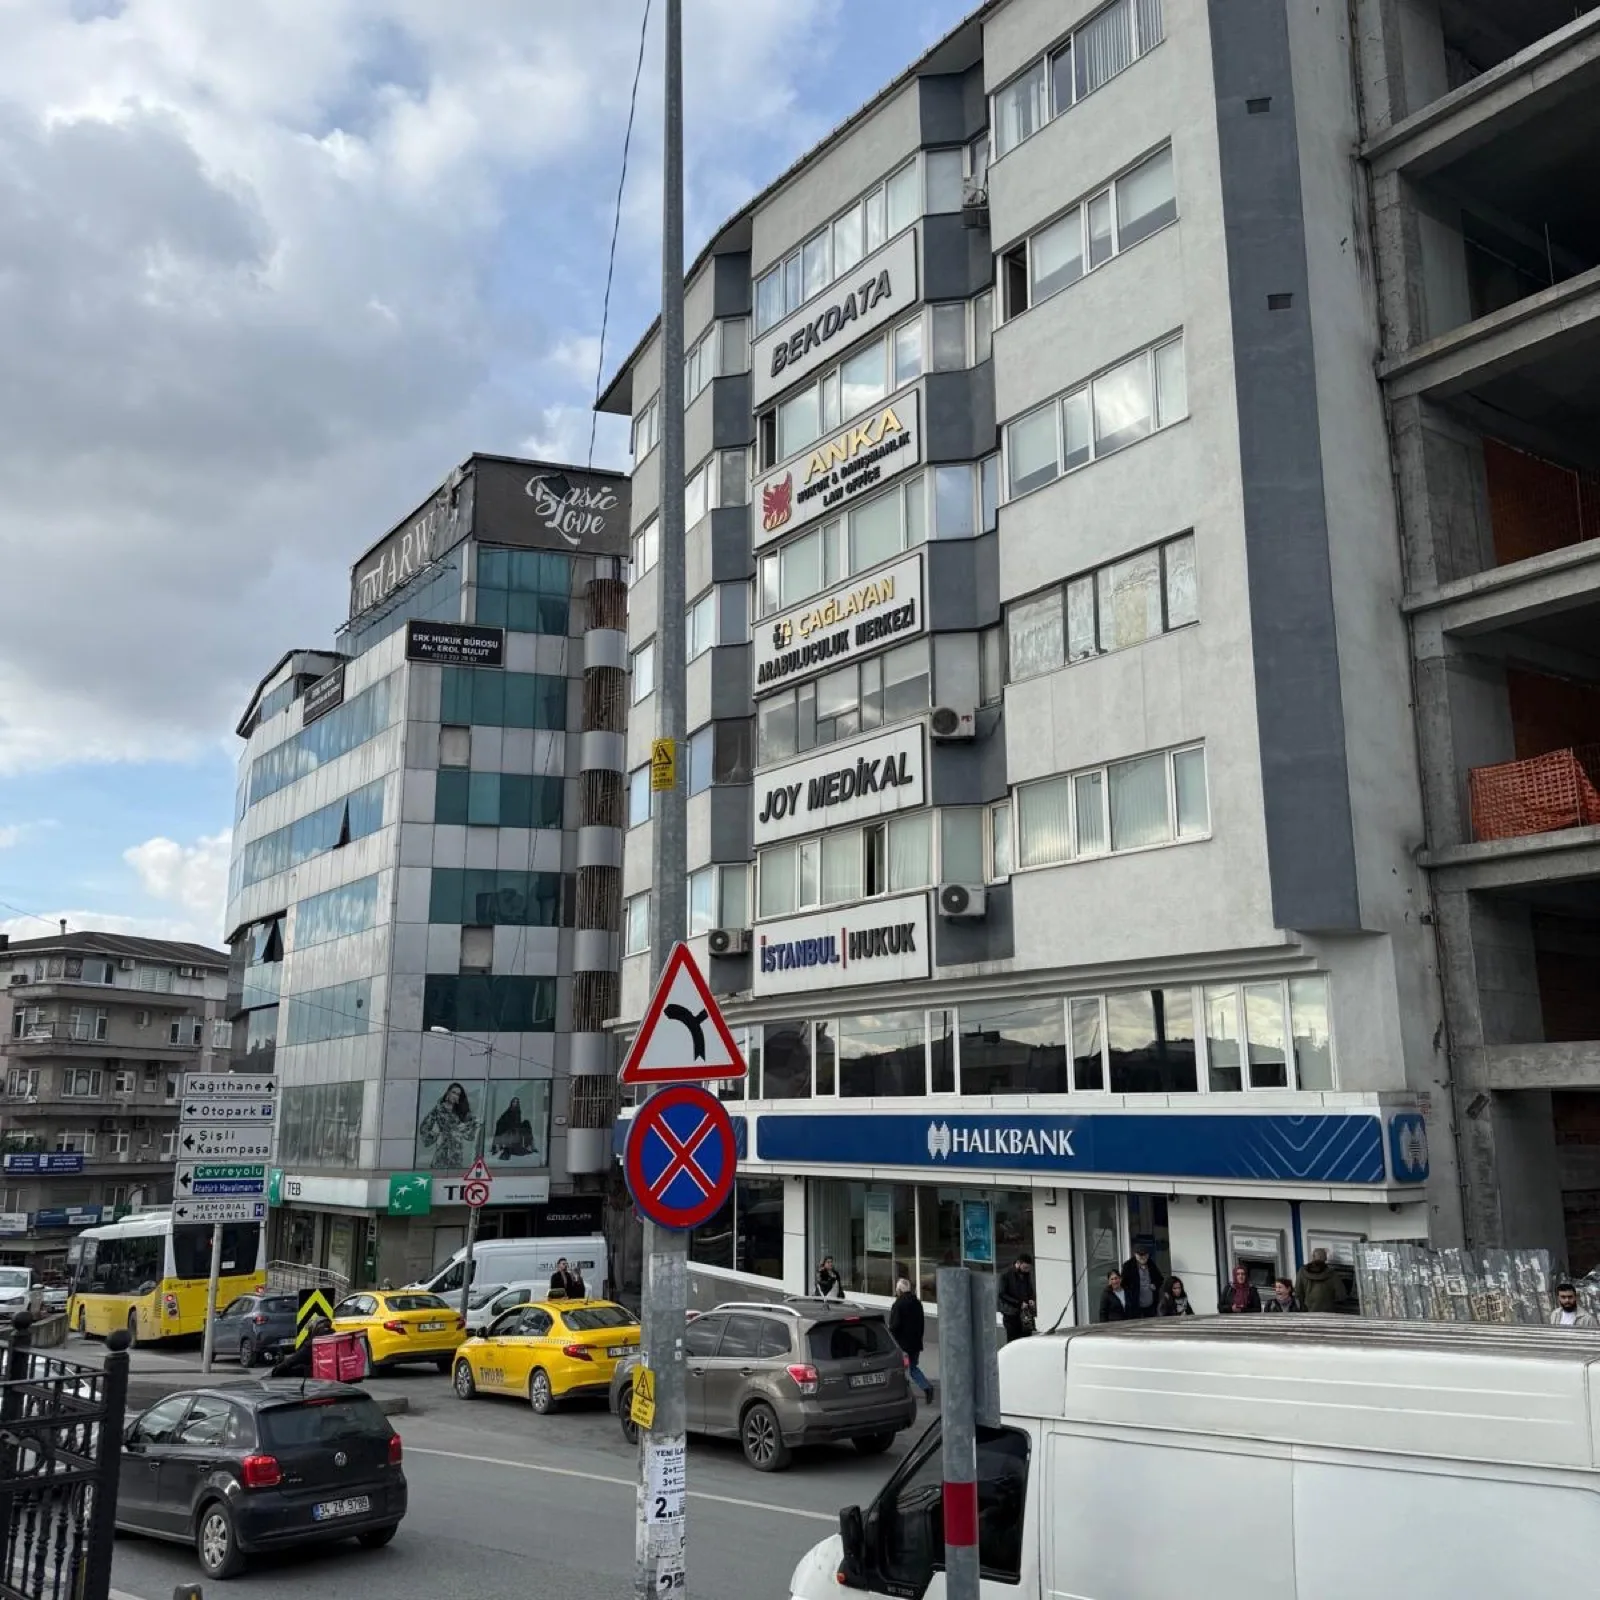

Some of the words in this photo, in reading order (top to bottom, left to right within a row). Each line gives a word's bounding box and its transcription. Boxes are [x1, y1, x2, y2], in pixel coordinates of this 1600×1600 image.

[770, 269, 891, 377] BEKDATA
[804, 408, 903, 485] ANKA
[797, 475, 830, 504] HUKUK
[823, 487, 844, 507] LAW
[545, 499, 606, 545] Love
[799, 576, 895, 639] ÇAĞLAYAN
[431, 635, 461, 645] HUKUK
[463, 637, 498, 649] BÜROSU
[462, 647, 490, 656] BULUT
[757, 629, 850, 684] ARABULUCULUK
[855, 597, 915, 646] MERKEZİ
[759, 782, 802, 823] JOY
[807, 752, 913, 811] MEDİKAL
[761, 935, 840, 973] İSTANBUL
[849, 922, 916, 960] HUKUK
[190, 1080, 262, 1092] Kağıthane
[201, 1105, 256, 1117] Otopark
[952, 1128, 1075, 1156] HALKBANK
[197, 1165, 262, 1178] Çevreyolu
[287, 1182, 301, 1196] TEB
[196, 1201, 246, 1211] MEMORIAL
[319, 1504, 329, 1516] 34
